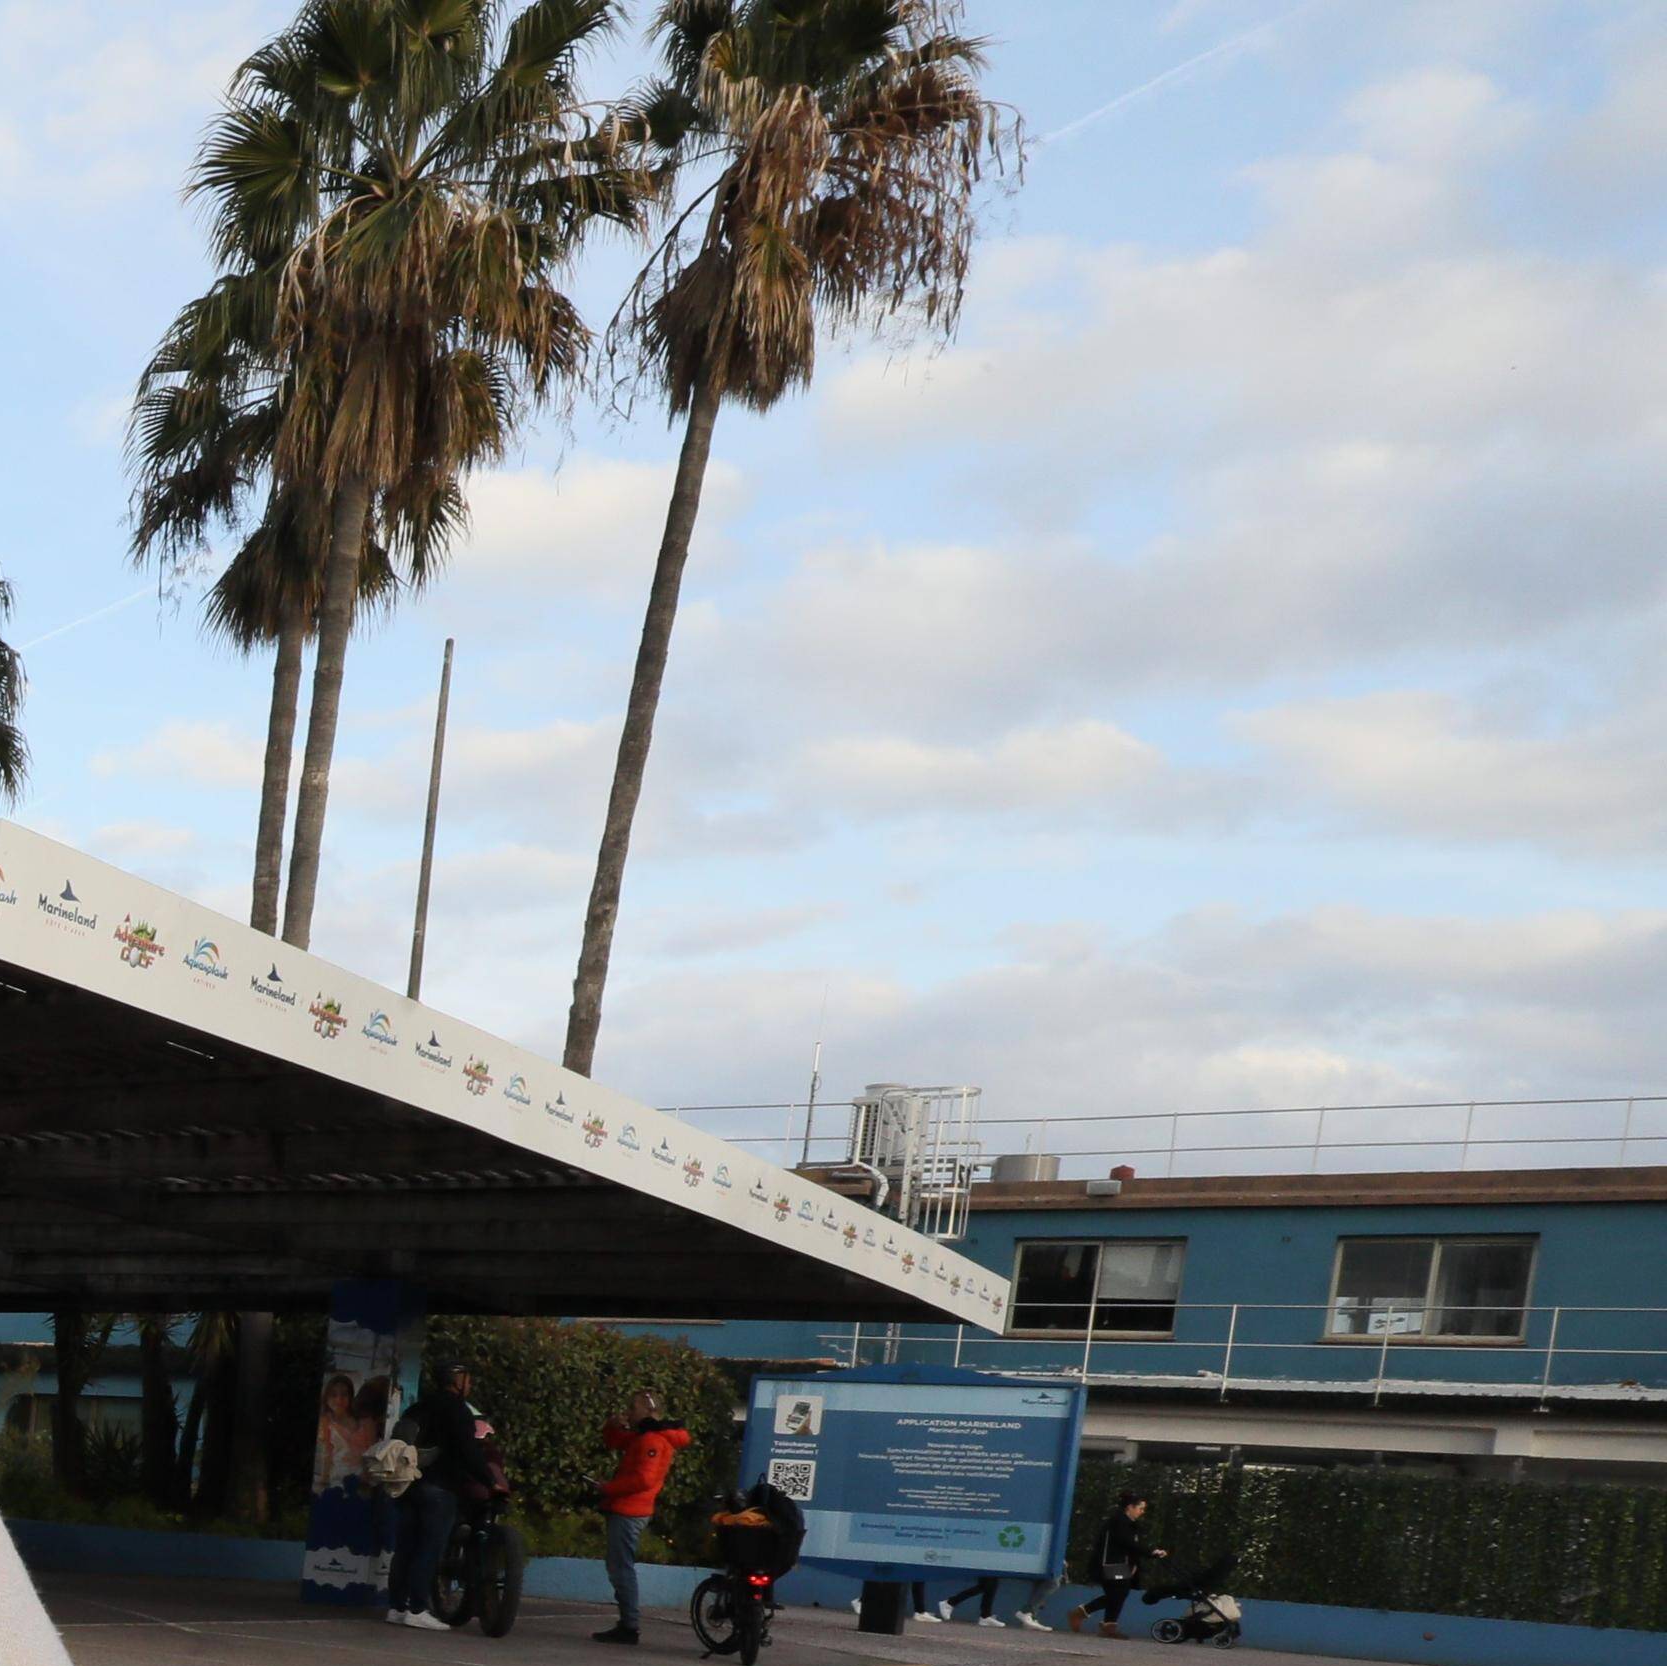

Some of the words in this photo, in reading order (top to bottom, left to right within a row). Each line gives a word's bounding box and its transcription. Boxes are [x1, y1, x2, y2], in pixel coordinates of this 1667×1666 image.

[37, 893, 98, 929] Marineland
[113, 925, 165, 957] Adventure
[250, 975, 297, 1006] Marineland
[896, 1418, 957, 1427] APPLICATION
[958, 1420, 1022, 1430] MARINELAND
